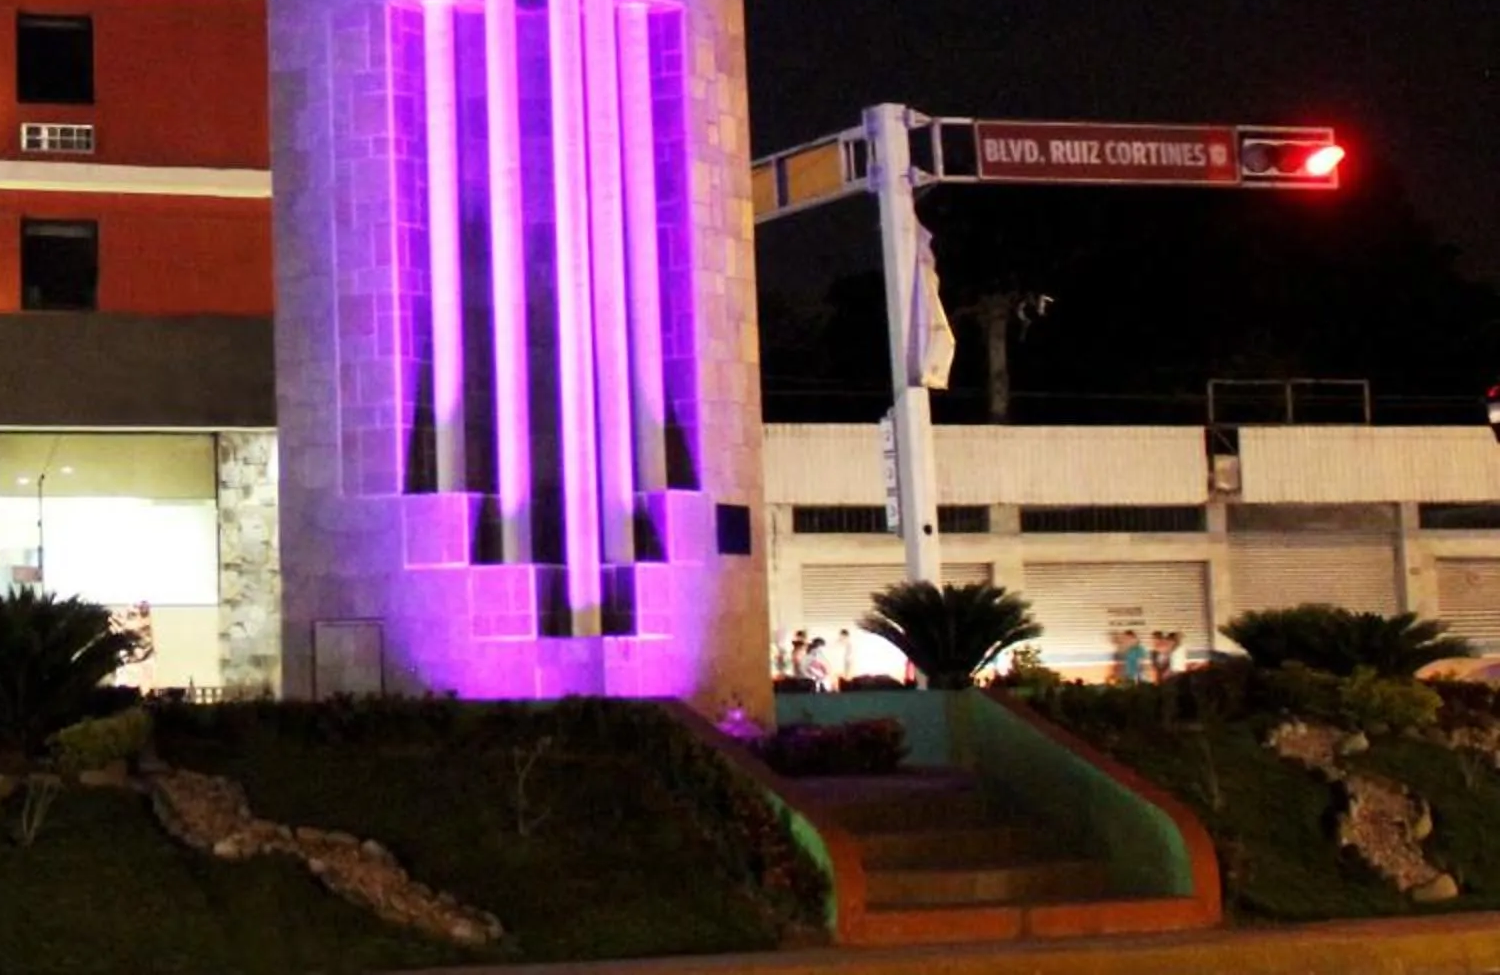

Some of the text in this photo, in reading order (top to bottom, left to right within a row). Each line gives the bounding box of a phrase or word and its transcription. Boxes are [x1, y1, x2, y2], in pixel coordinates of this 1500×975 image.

[984, 138, 1207, 167] BLVD. RUIZ CORTINES
